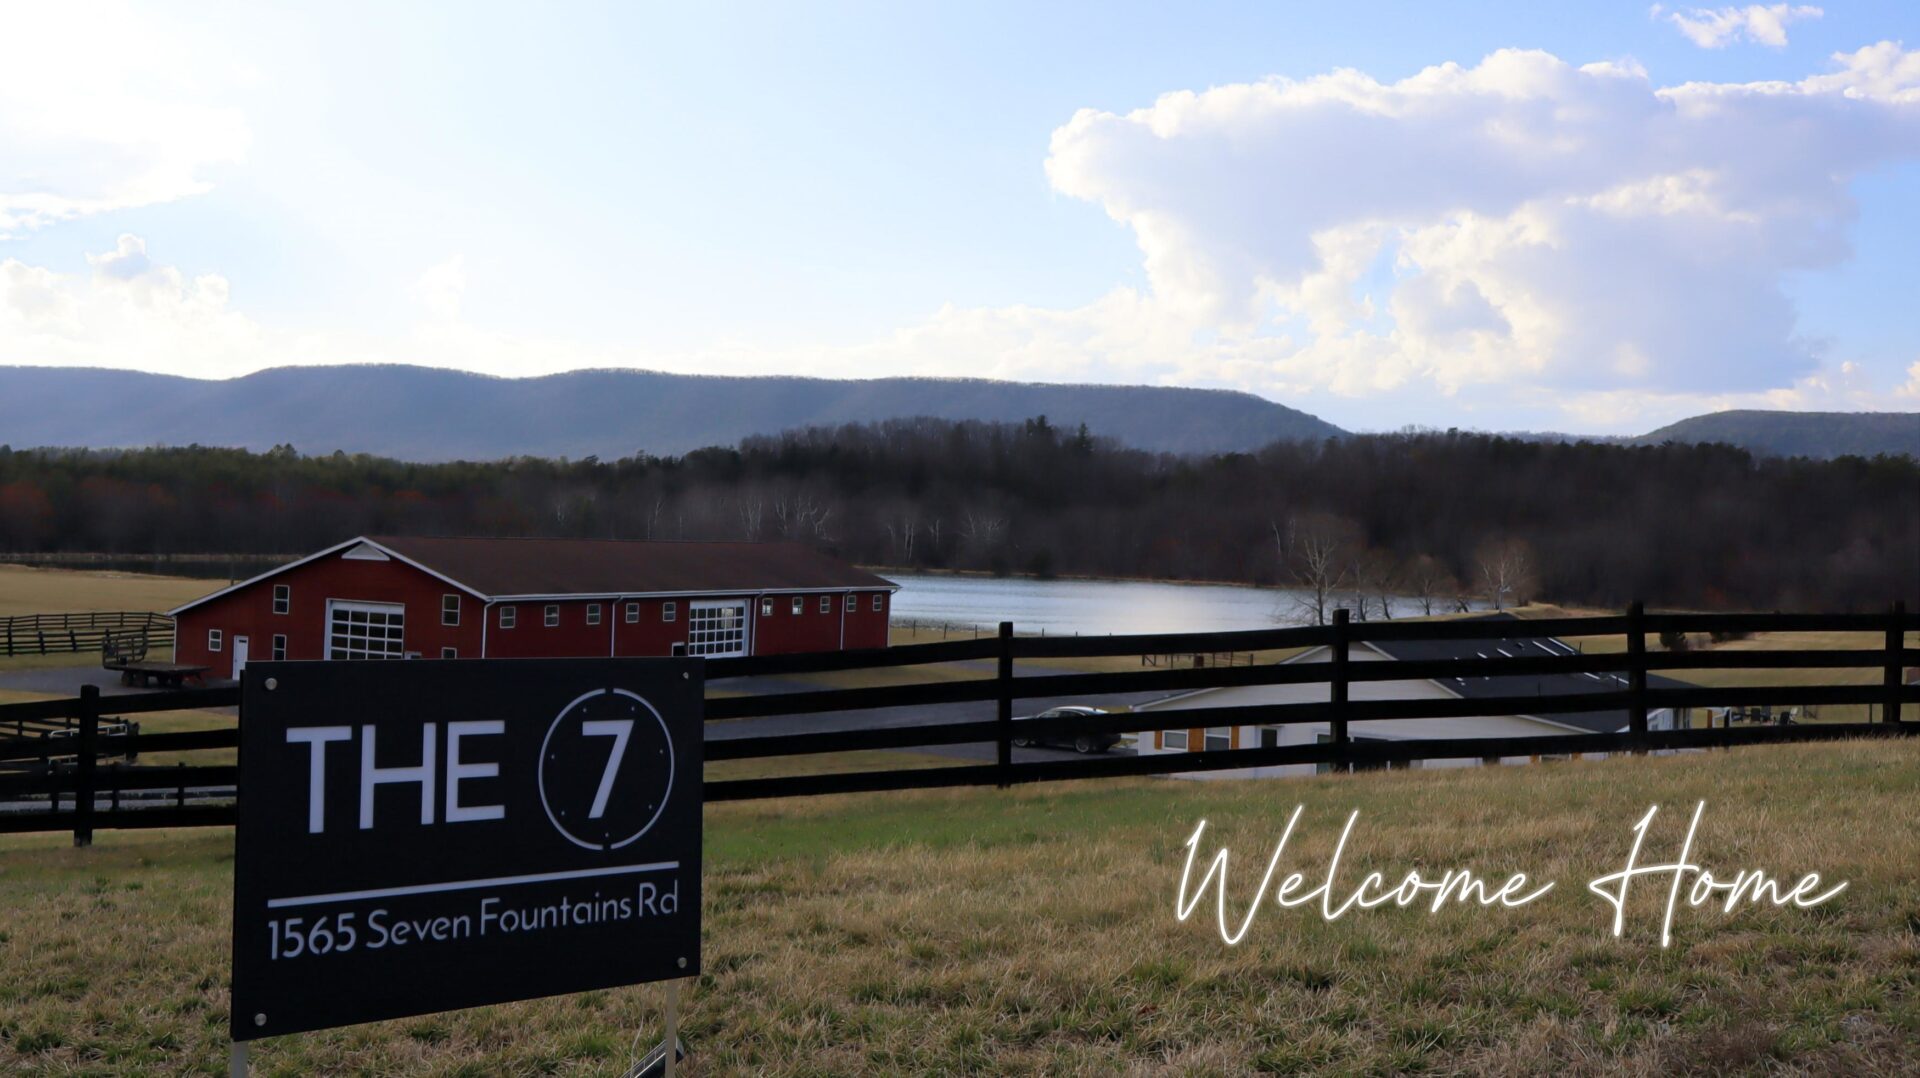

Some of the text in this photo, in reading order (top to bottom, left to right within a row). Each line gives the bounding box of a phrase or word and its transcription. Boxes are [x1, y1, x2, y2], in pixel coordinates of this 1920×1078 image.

[286, 719, 634, 834] THE 7
[268, 879, 678, 960] 1565 Seven Fountains Rd
